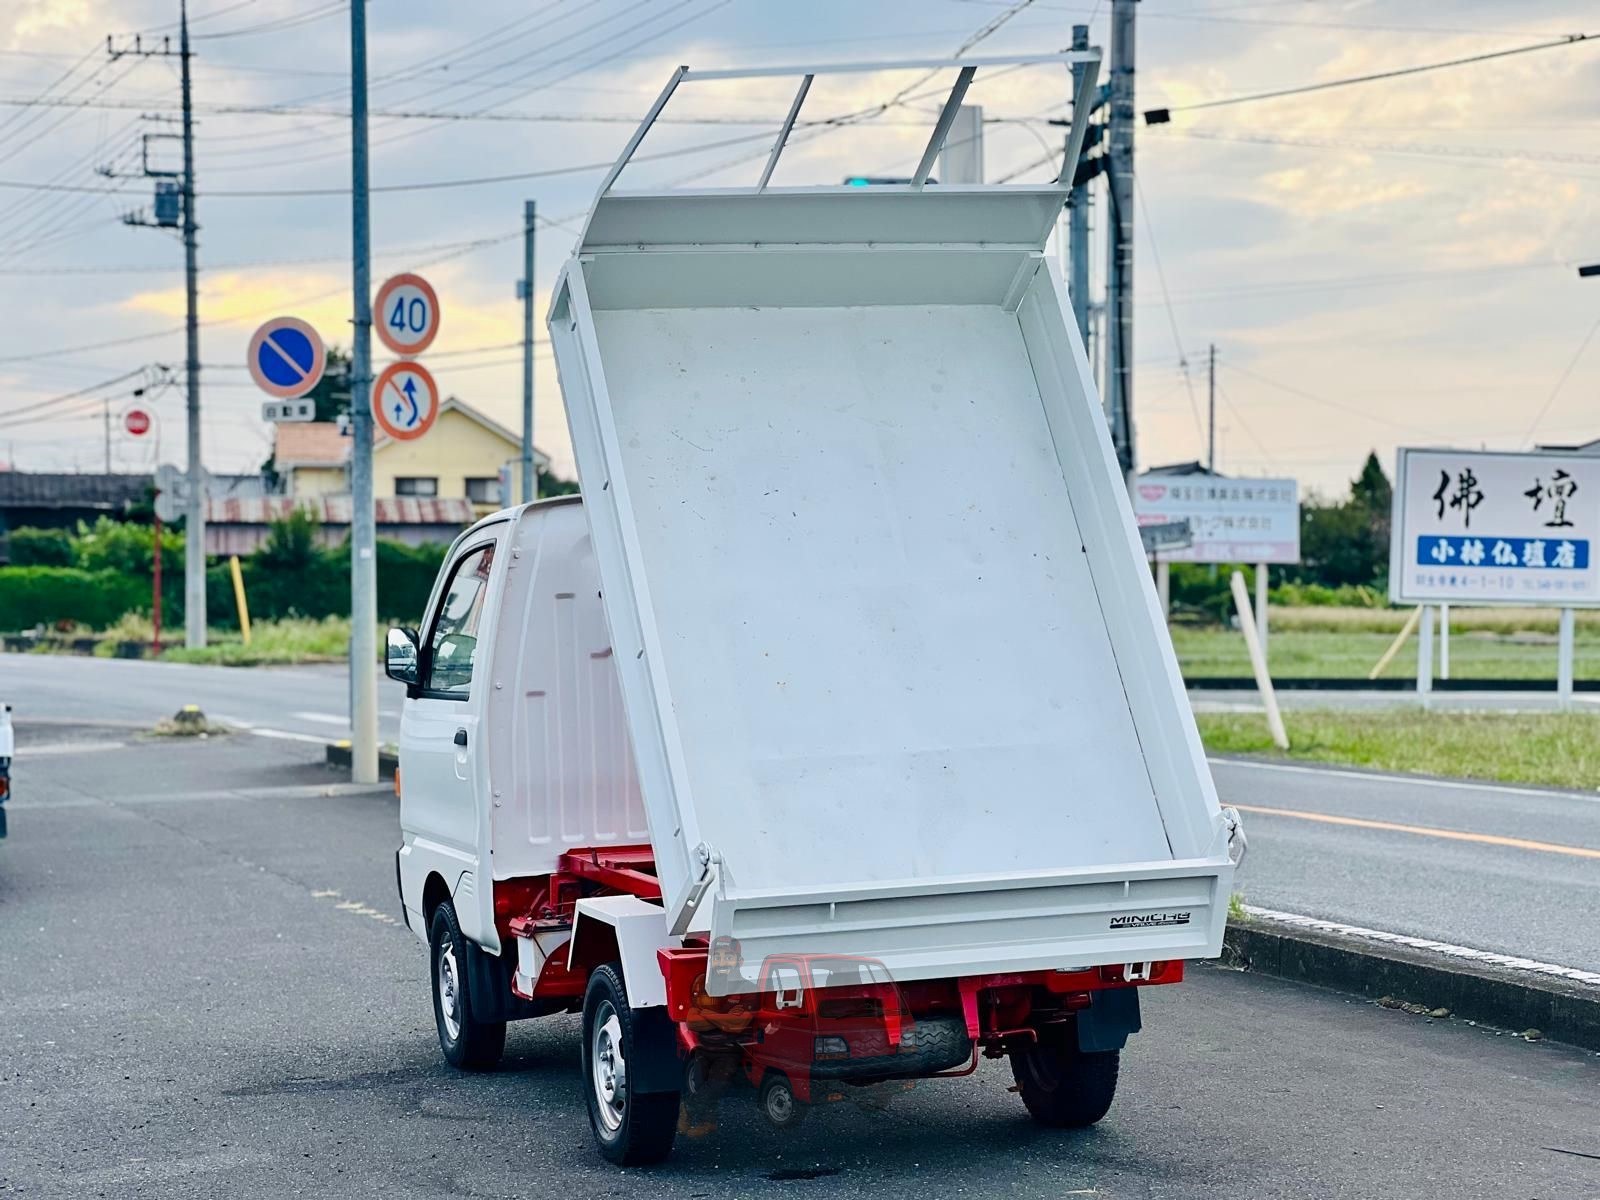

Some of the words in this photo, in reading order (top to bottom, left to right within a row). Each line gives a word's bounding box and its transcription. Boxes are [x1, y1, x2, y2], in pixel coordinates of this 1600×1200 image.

[390, 297, 426, 333] 40
[1431, 538, 1576, 568] 小林仏壇店
